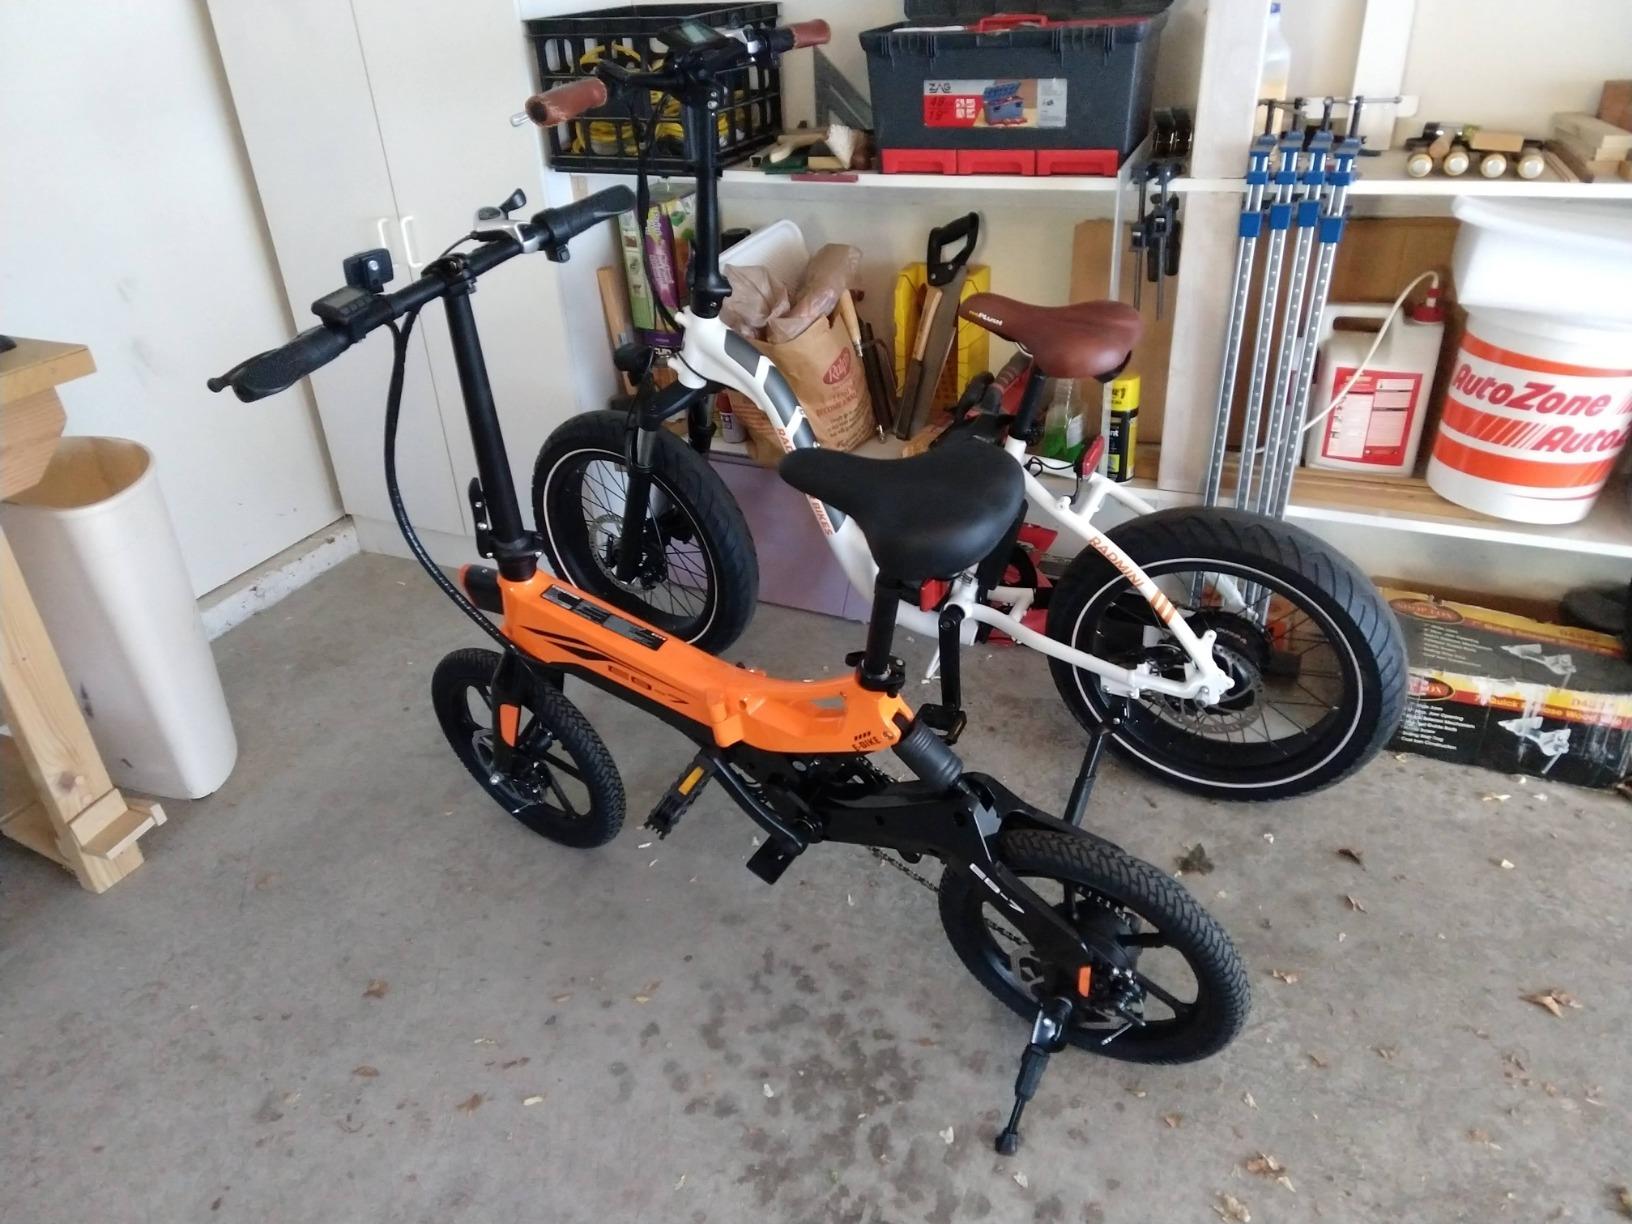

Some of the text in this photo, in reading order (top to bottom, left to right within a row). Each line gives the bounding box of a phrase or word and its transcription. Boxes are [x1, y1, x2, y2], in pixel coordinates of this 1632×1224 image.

[928, 82, 952, 94] ZAG
[1452, 363, 1612, 417] AutoZone
[1089, 536, 1144, 588] RADMINI
